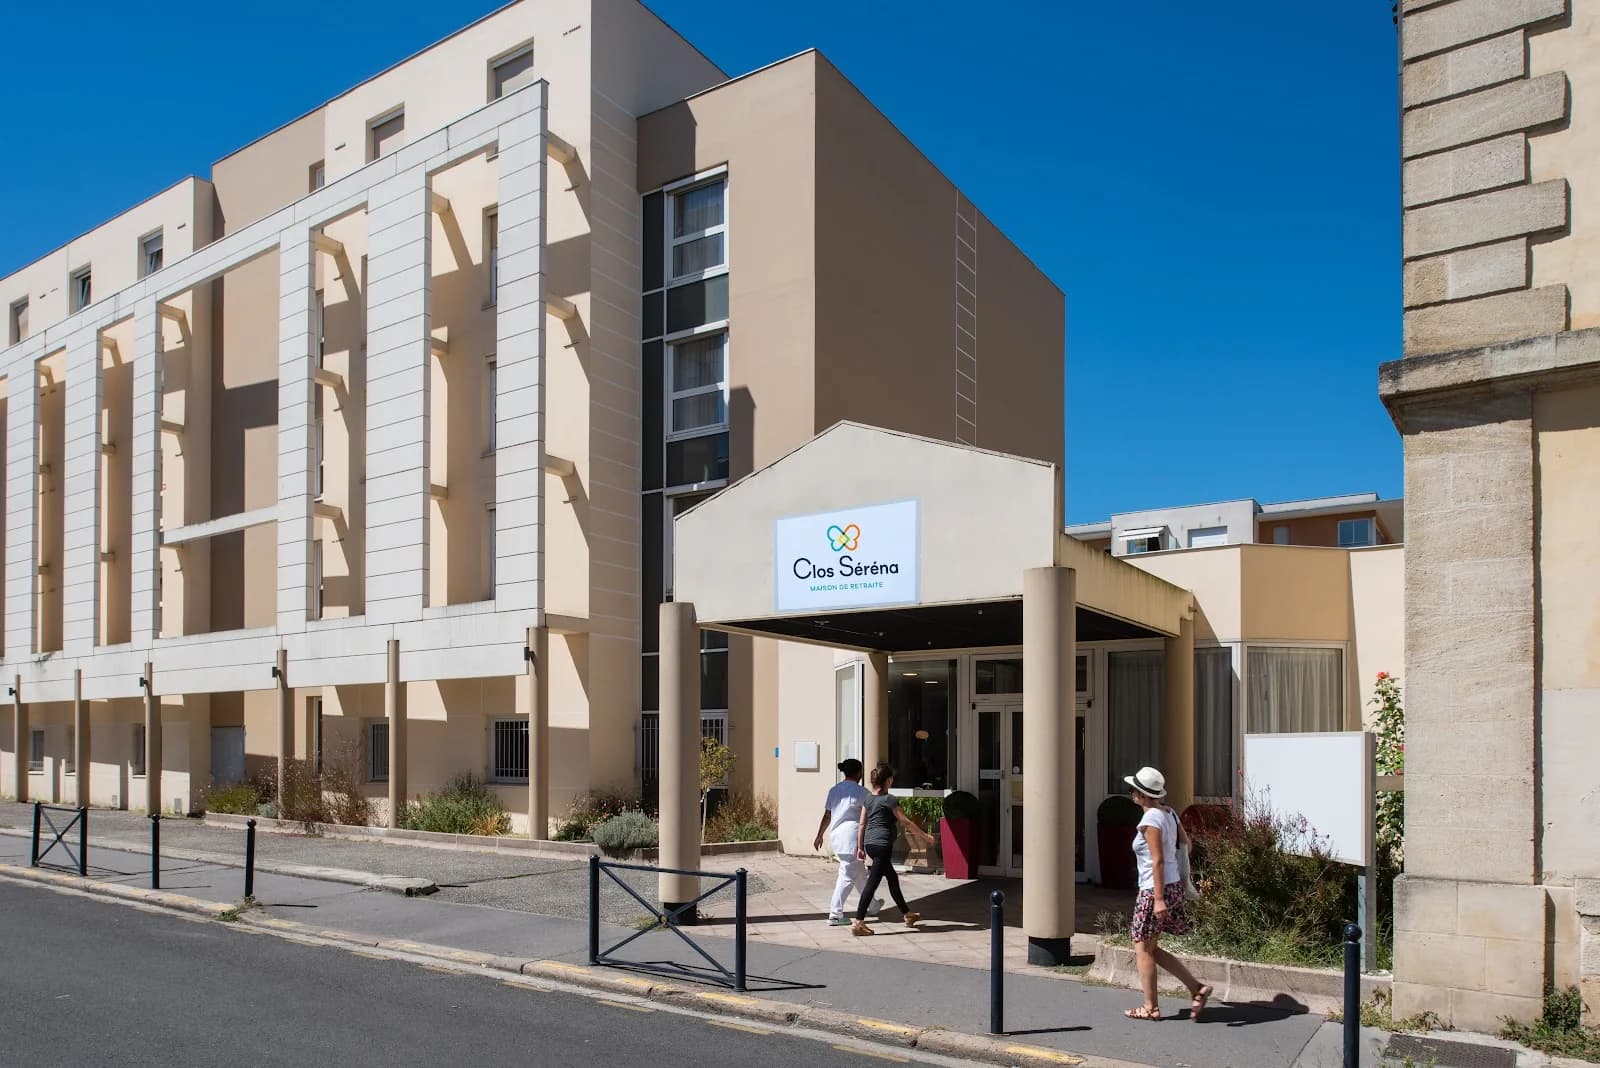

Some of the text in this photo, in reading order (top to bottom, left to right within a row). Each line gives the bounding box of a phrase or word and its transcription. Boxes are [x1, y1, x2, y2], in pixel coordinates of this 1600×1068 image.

[793, 555, 899, 579] Clos Séréna
[810, 584, 838, 592] MAISON
[850, 581, 884, 589] RETRAITE
